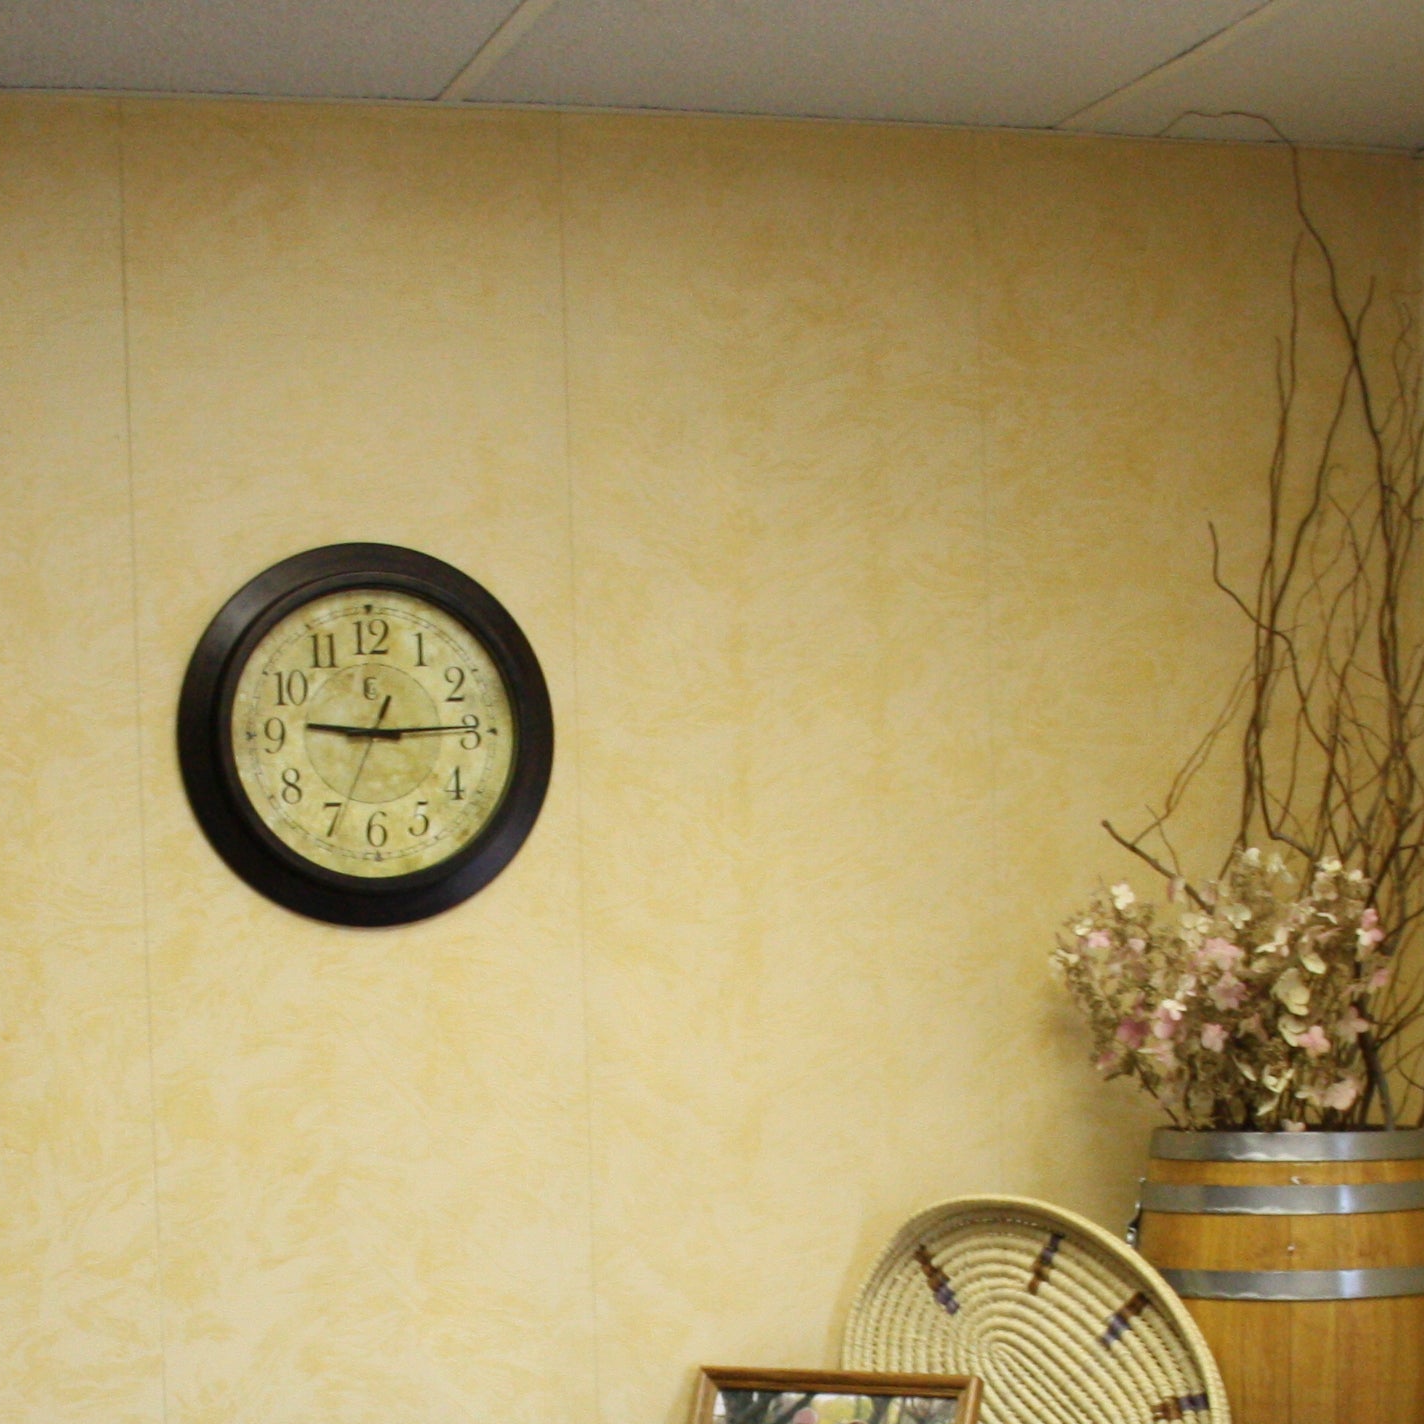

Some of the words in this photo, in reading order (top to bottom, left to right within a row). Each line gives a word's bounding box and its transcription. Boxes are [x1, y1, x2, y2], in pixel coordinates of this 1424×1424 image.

[310, 633, 339, 668] 11
[353, 619, 389, 655] 12
[414, 632, 428, 667] 1
[275, 670, 308, 706] 10
[445, 666, 465, 702] 2
[264, 717, 286, 754] 9
[460, 714, 481, 750] 3
[281, 768, 303, 804] 8
[445, 766, 465, 801] 4
[323, 802, 342, 838] 7
[366, 812, 388, 848] 6
[408, 802, 429, 837] 5
